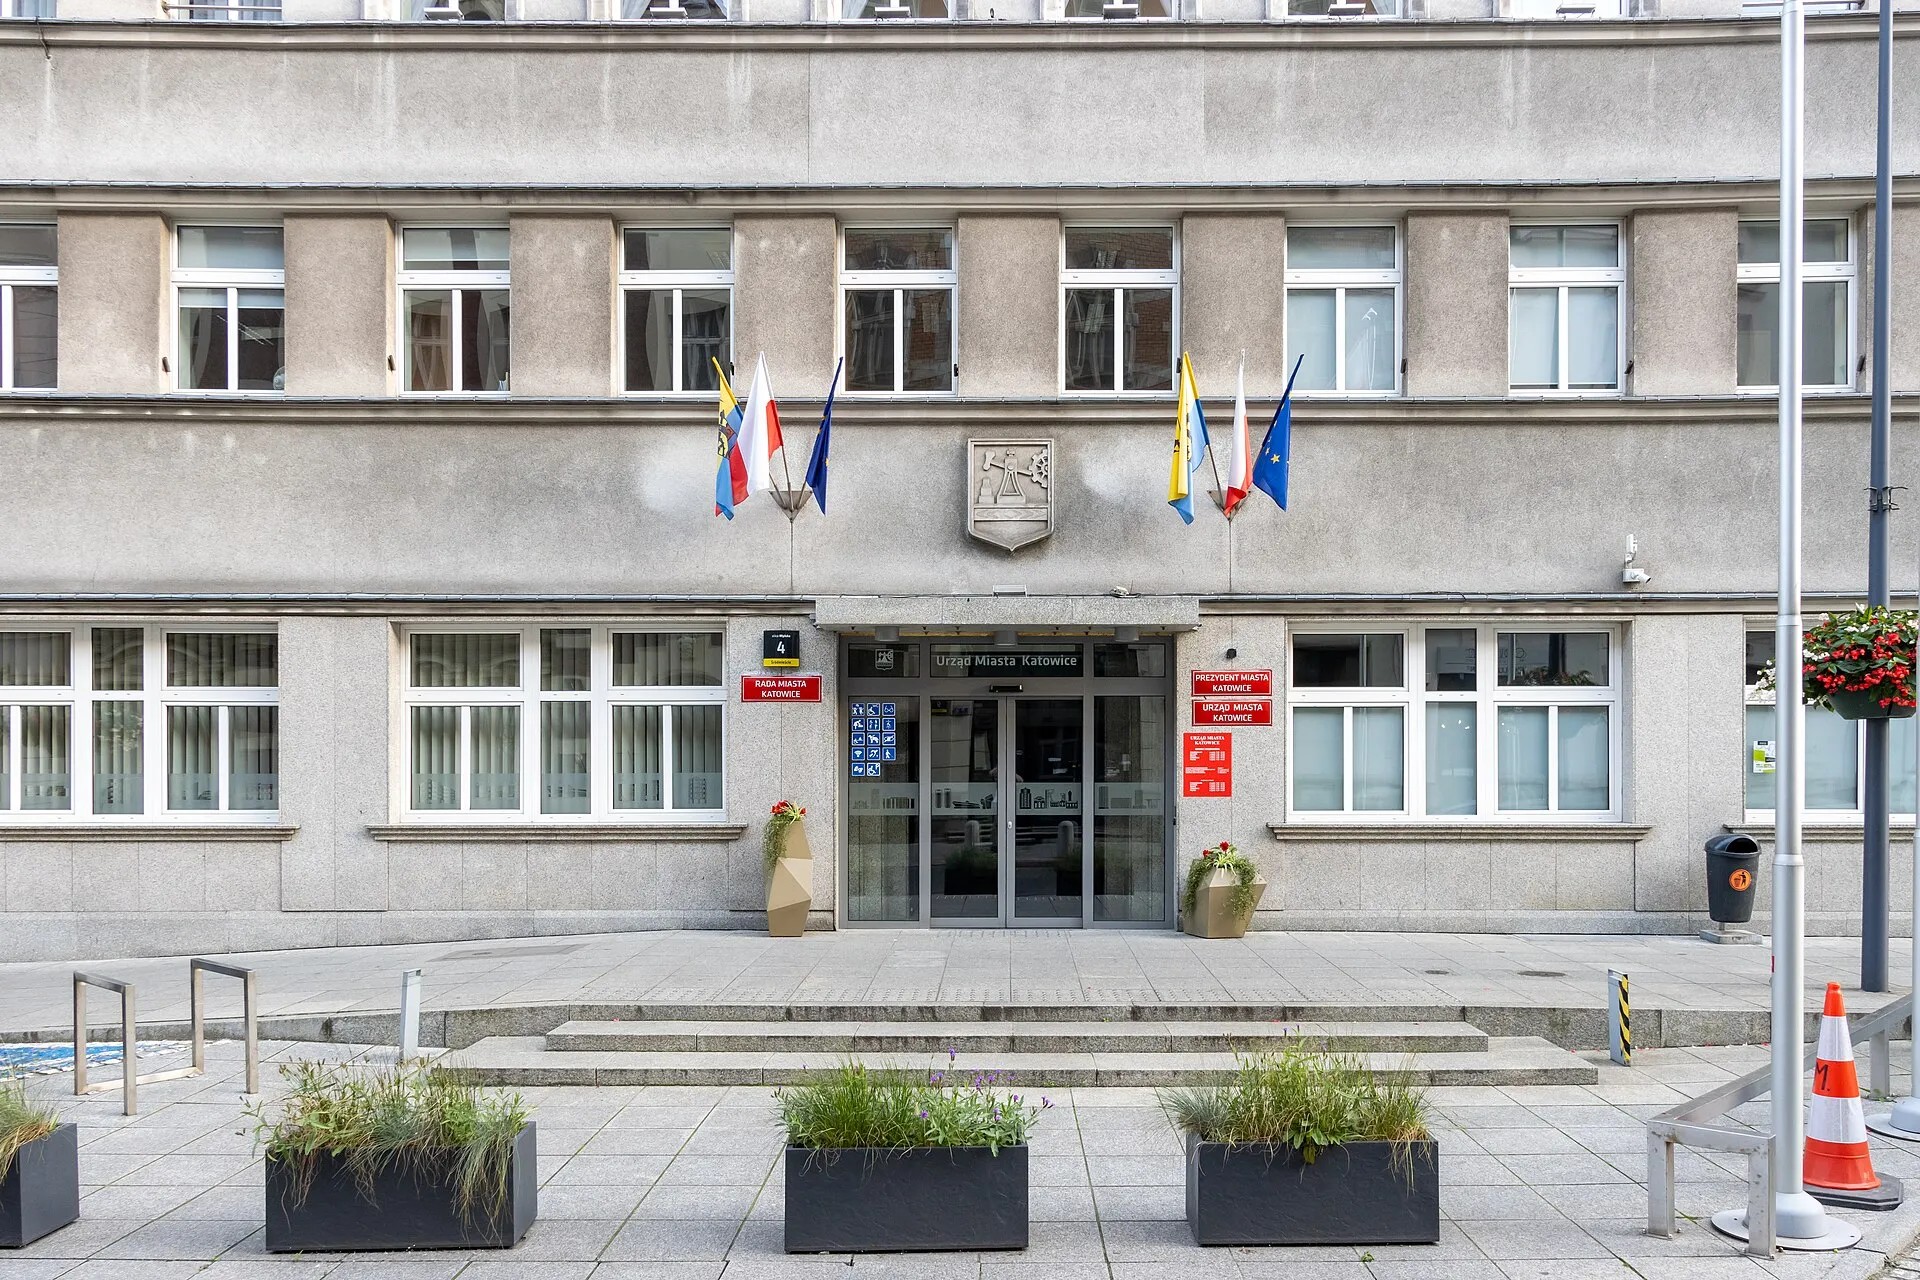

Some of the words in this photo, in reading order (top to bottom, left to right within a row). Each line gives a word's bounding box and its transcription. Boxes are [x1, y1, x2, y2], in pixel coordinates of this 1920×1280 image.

[776, 641, 786, 654] 4
[936, 655, 971, 669] Urząd
[975, 655, 1016, 666] Miasta
[1022, 654, 1077, 666] Katowice
[1212, 684, 1252, 692] KATOWICE
[761, 690, 801, 698] KATOWICE
[1202, 704, 1230, 712] URZĄD
[1213, 714, 1252, 722] KATOWICE
